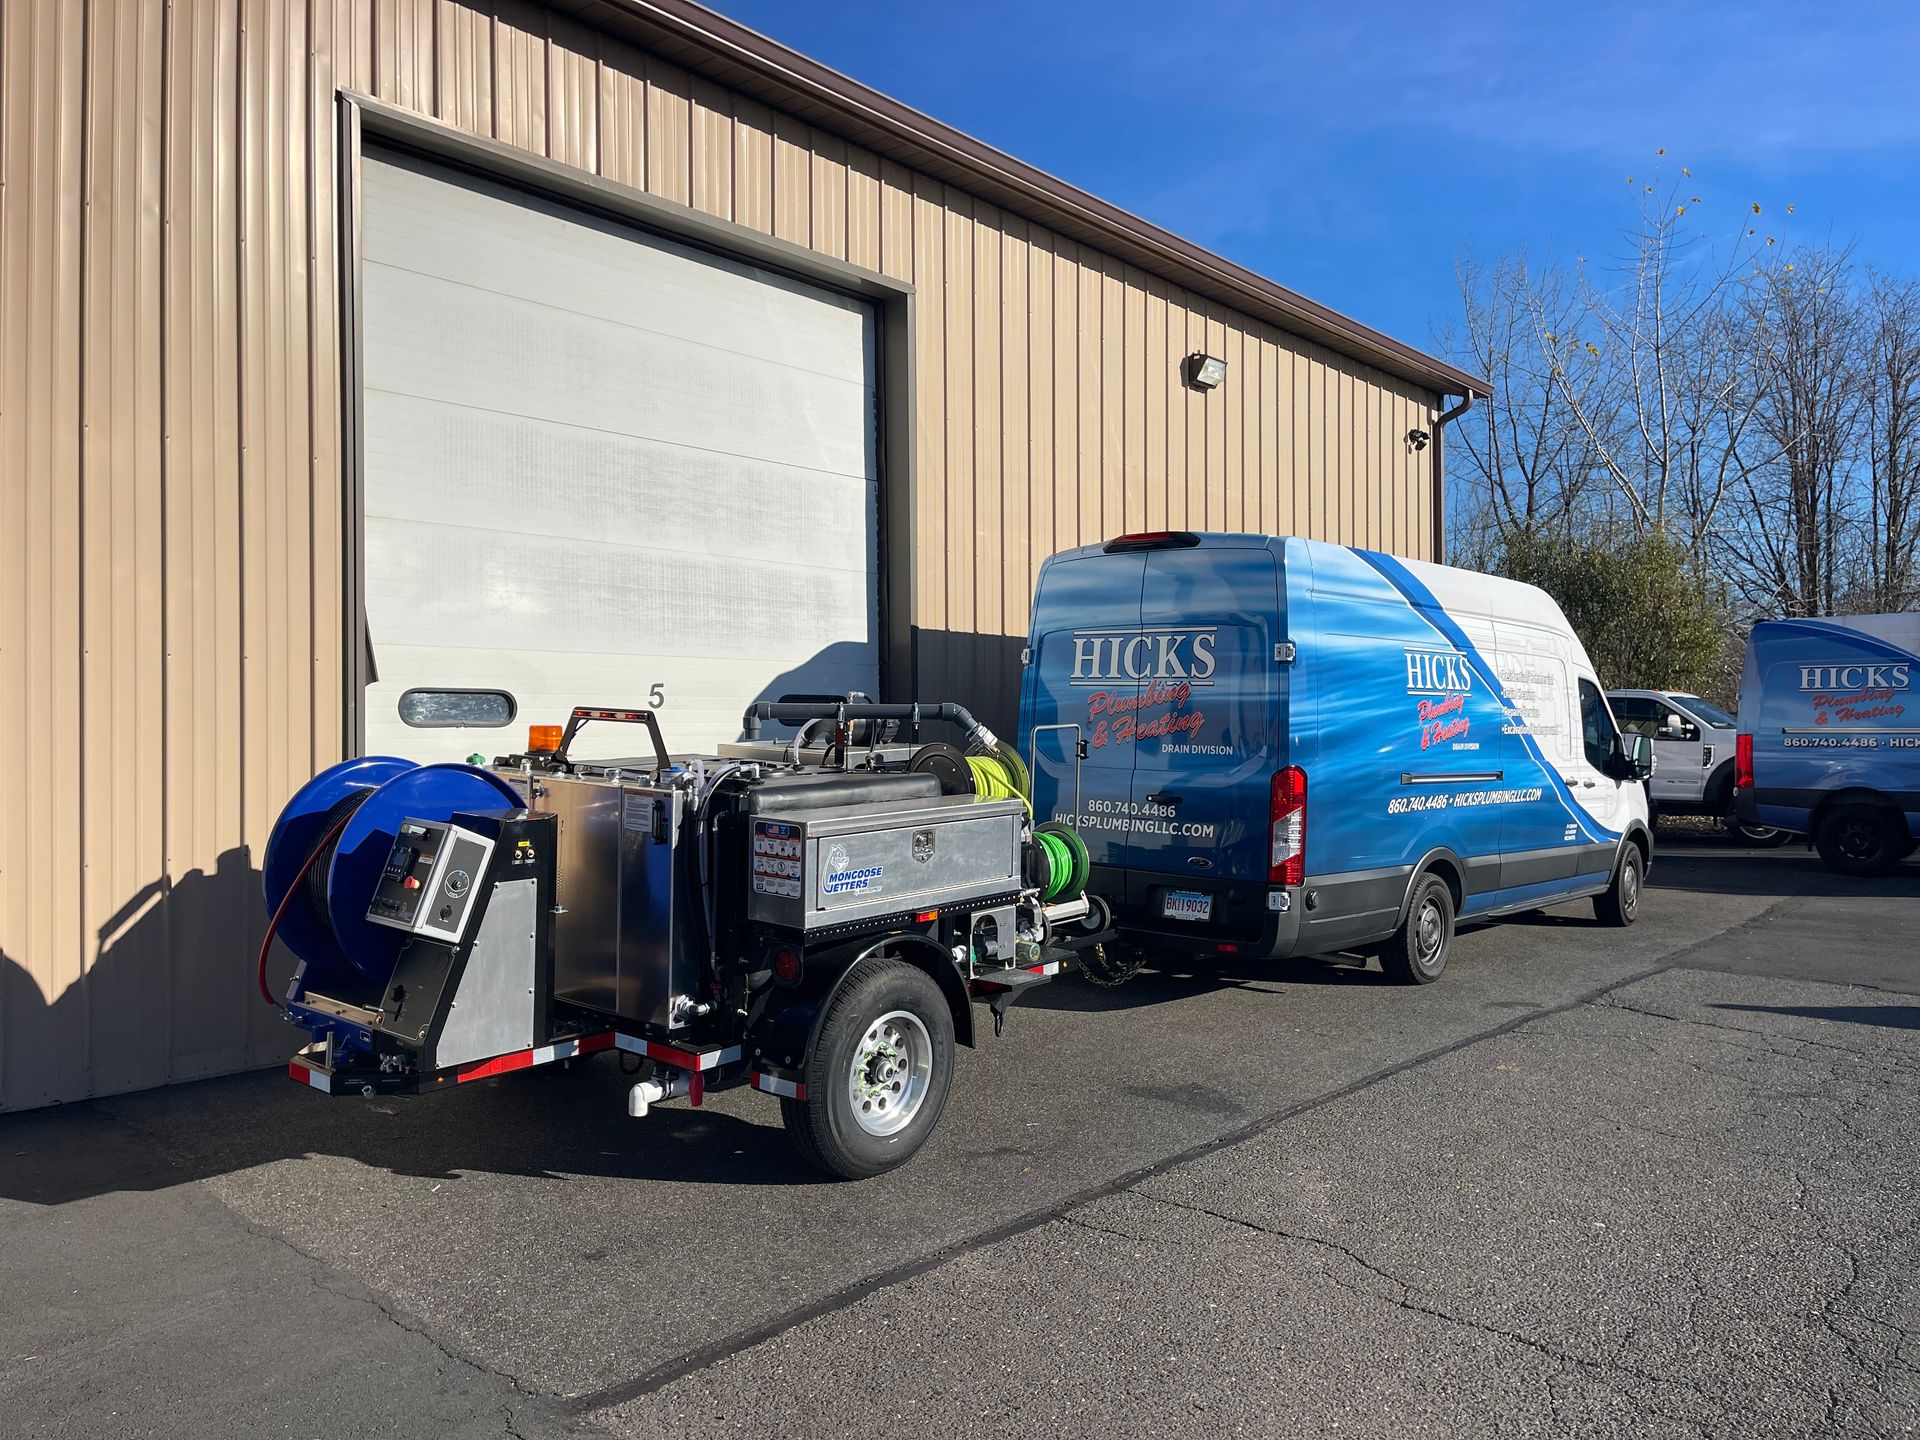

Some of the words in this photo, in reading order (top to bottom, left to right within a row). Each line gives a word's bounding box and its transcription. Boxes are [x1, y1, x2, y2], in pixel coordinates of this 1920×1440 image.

[1070, 633, 1216, 679] HICKS
[1406, 653, 1471, 691] HICKS
[1800, 666, 1909, 689] HICKS
[647, 683, 664, 708] 5
[1087, 679, 1191, 721] Plumbing
[1814, 688, 1893, 709] Plumbing
[1417, 690, 1464, 727] Plumbing
[1815, 711, 1828, 726] &
[1835, 702, 1905, 721] Heating
[1091, 718, 1108, 748] &
[1112, 711, 1205, 744] Heating
[1431, 716, 1470, 746] Heating
[1162, 744, 1189, 754] DRAIN
[1192, 744, 1233, 755] DIVISION
[1784, 738, 1877, 747] 860.740.4486
[1088, 800, 1176, 818] 860.740.4486
[1388, 794, 1449, 814] 860.740.4486
[1454, 788, 1542, 807] HICKSPLUMBINGLLC.COM
[1055, 813, 1214, 838] HICKSPLUMBINGLLC.COM
[823, 879, 869, 893] JETTERS
[829, 867, 882, 883] MONGOOSE
